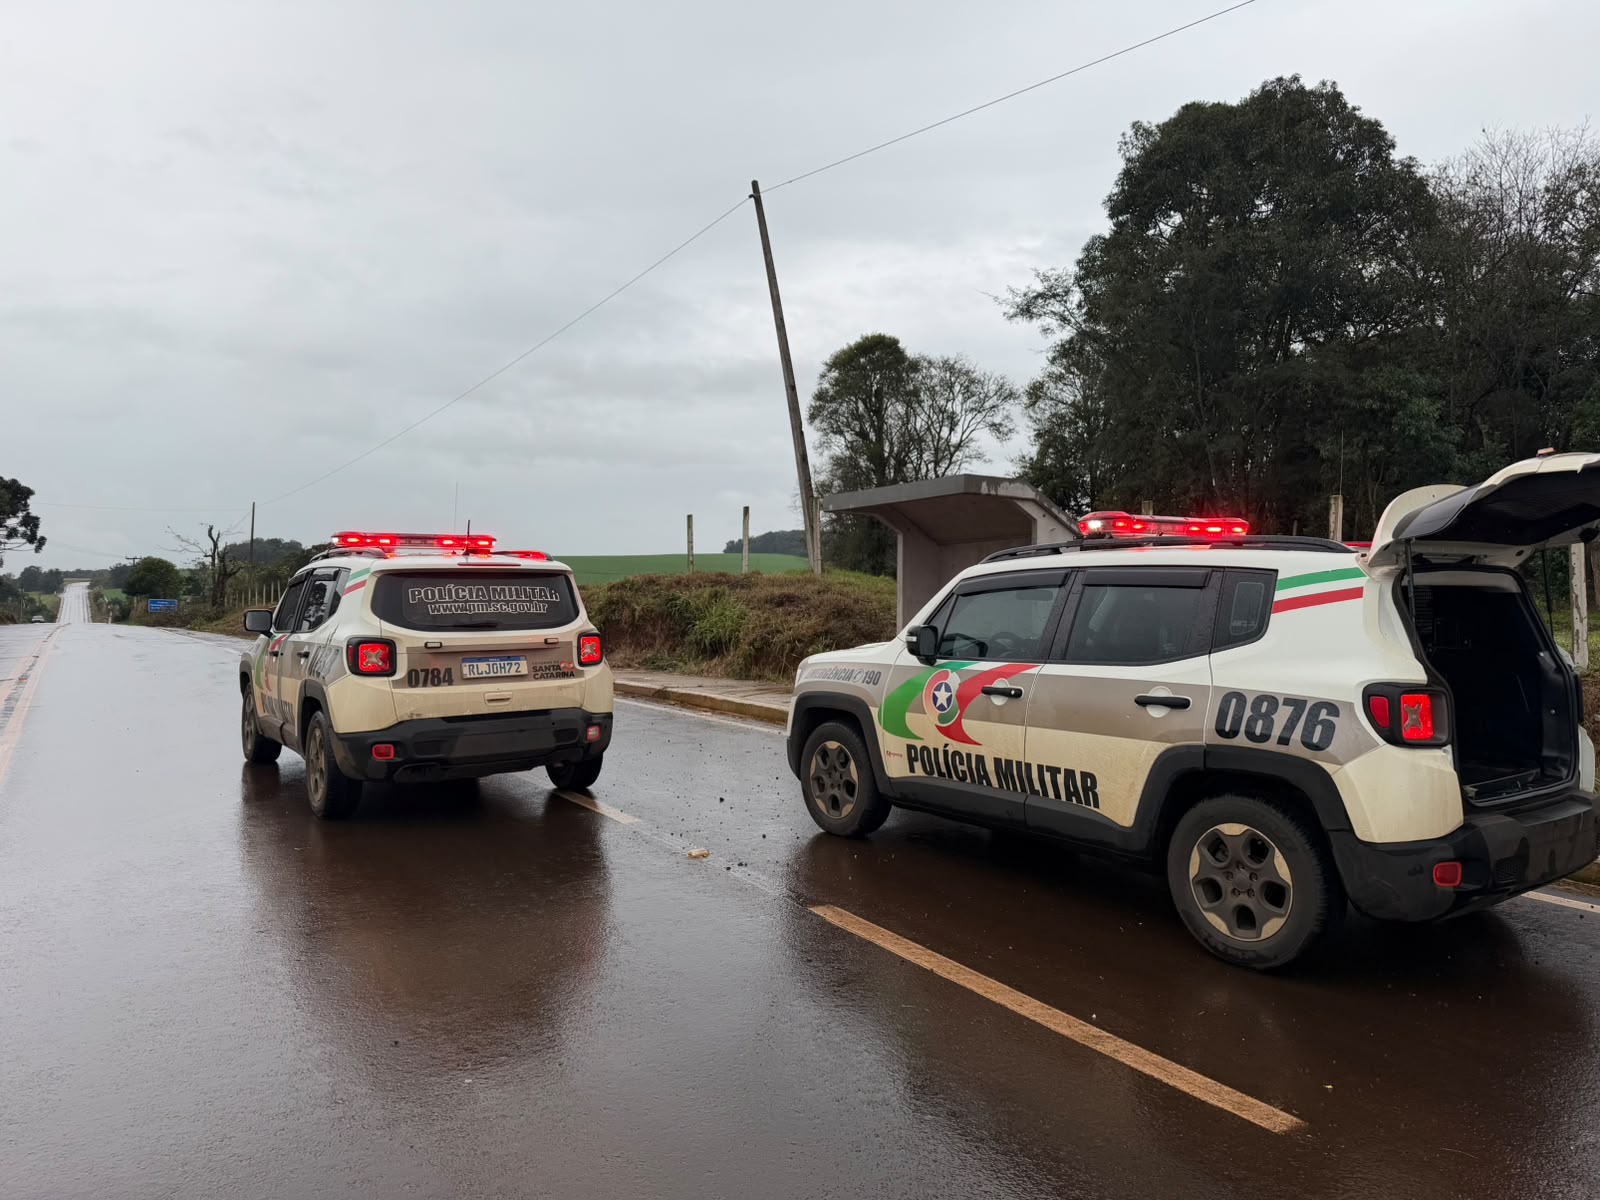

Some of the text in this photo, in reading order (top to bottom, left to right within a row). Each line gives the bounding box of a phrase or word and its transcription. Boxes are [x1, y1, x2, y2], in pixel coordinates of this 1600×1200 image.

[408, 584, 560, 603] POLÍCIA MILITAR
[428, 601, 548, 614] www.pm.sc.gov.br
[407, 668, 454, 688] 0784
[533, 671, 575, 680] CATARINA
[862, 670, 882, 686] 190
[1214, 691, 1340, 751] 0876
[906, 743, 1100, 809] POLÍCIA MILITAR
